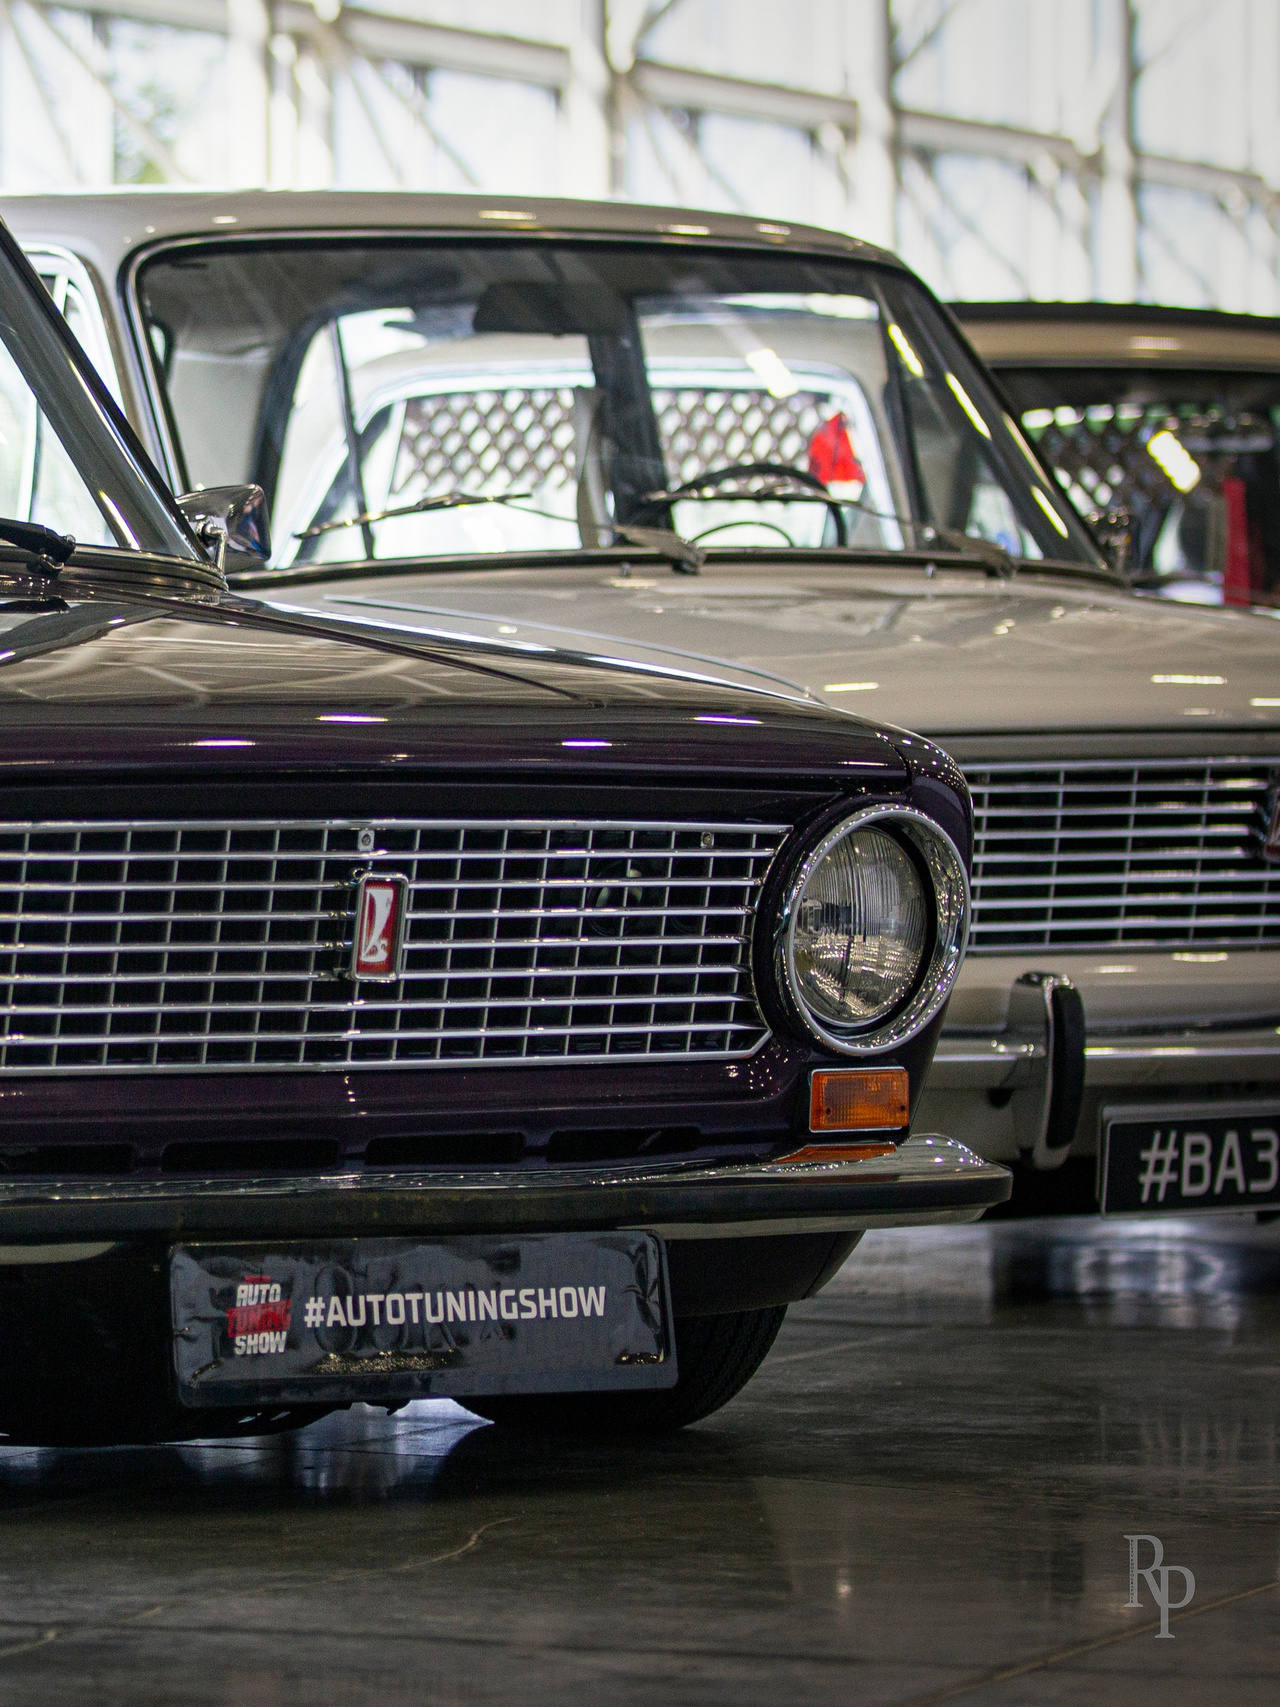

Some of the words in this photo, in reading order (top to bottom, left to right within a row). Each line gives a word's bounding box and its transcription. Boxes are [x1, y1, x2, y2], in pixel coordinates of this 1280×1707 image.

[236, 1283, 281, 1308] AUTO
[304, 1286, 606, 1329] #AUTOTUNINGSHOW
[234, 1331, 287, 1355] SHOW
